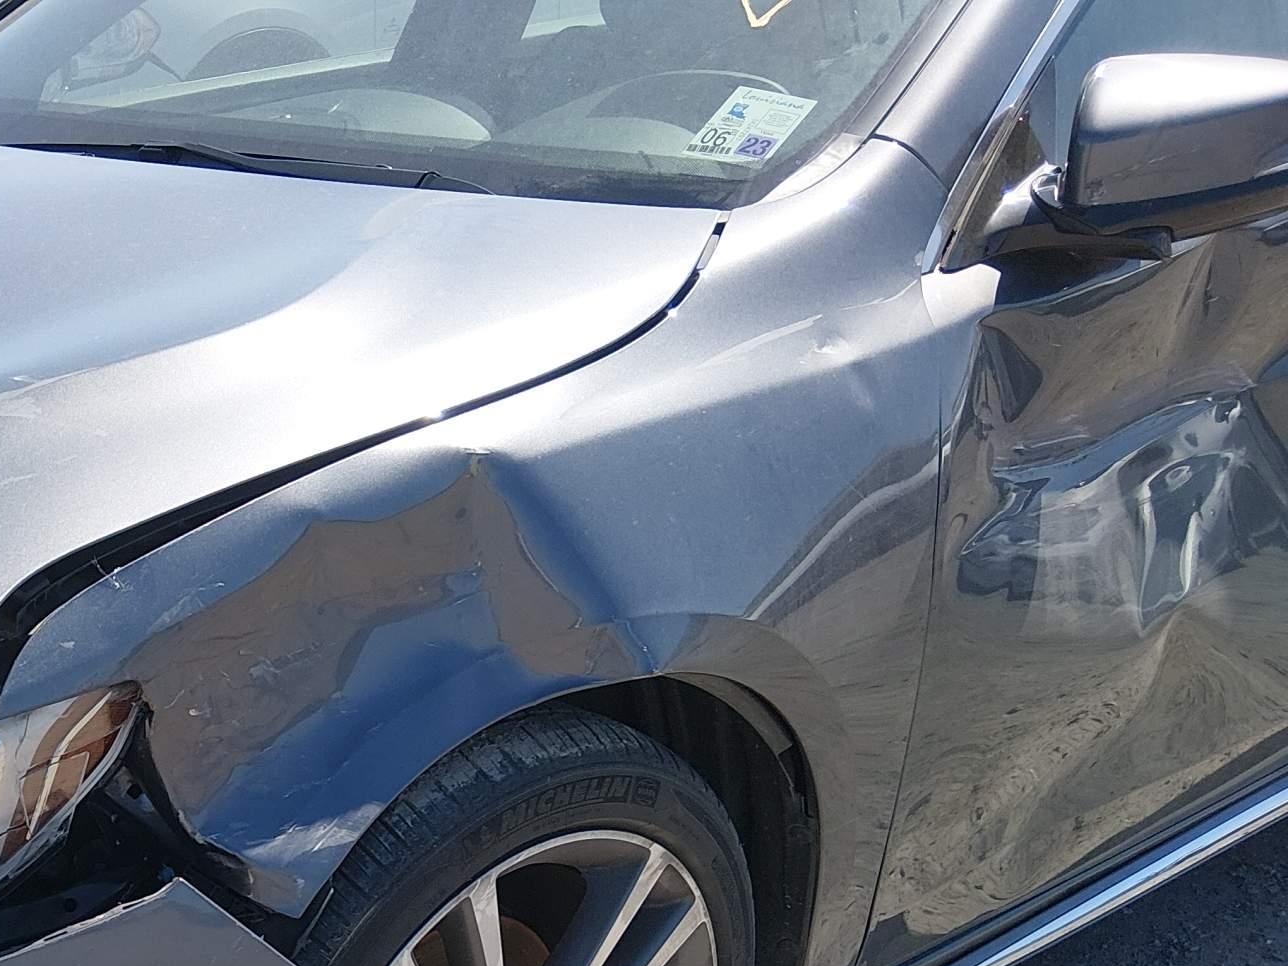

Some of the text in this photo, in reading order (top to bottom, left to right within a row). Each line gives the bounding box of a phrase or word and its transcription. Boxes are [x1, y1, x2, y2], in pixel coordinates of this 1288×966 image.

[699, 127, 732, 147] 06
[737, 136, 773, 156] 23
[500, 775, 631, 830] MICHELIN
